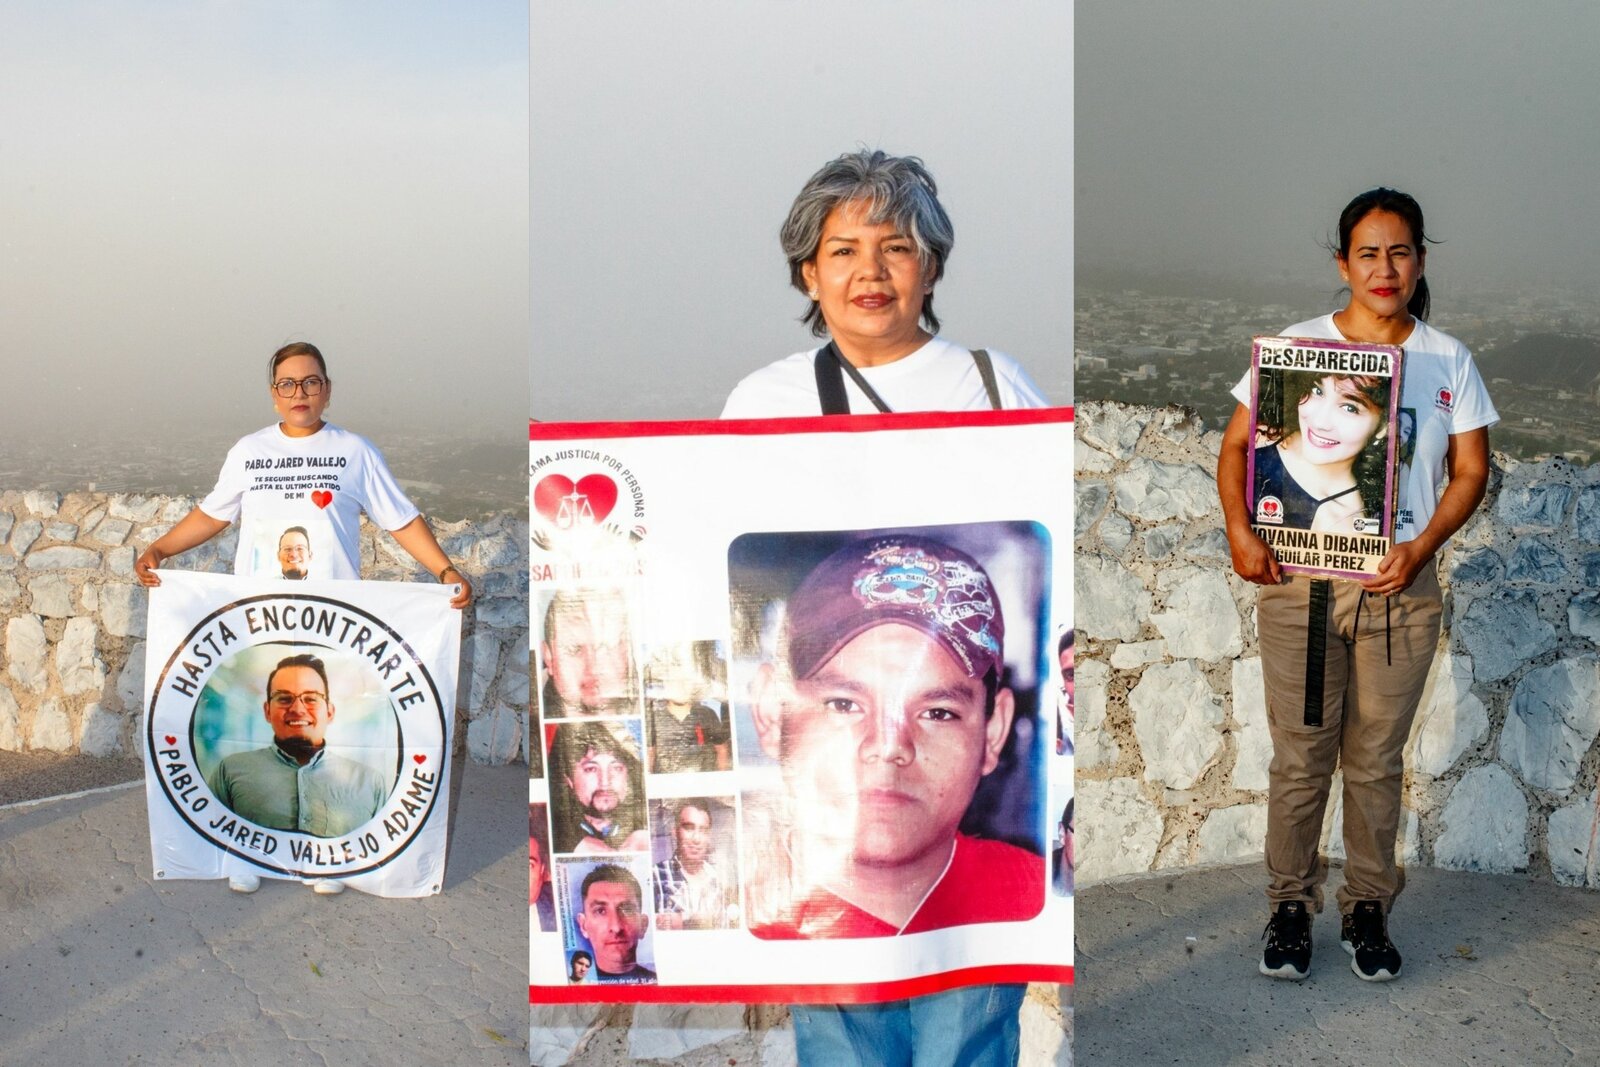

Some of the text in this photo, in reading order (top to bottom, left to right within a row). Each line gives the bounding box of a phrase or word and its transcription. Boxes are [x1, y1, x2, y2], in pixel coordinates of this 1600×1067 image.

[1261, 346, 1390, 374] DESAPARECIDA
[245, 457, 346, 471] PABLO JARED VALLEJO
[250, 483, 273, 491] HASTA
[285, 482, 313, 490] ULTIMO
[314, 482, 341, 491] LATIDO
[284, 492, 295, 500] DE
[555, 449, 600, 461] JUSTICIA
[602, 455, 623, 472] POR
[621, 469, 645, 518] PERSONAS
[1253, 527, 1387, 556] OVANNA DIBANHI
[1271, 547, 1366, 571] GUILAR PEREZ
[171, 605, 425, 712] HASTA ENCONTRARTE
[159, 748, 435, 867] PABLO JARED VALLEJO ADAME
